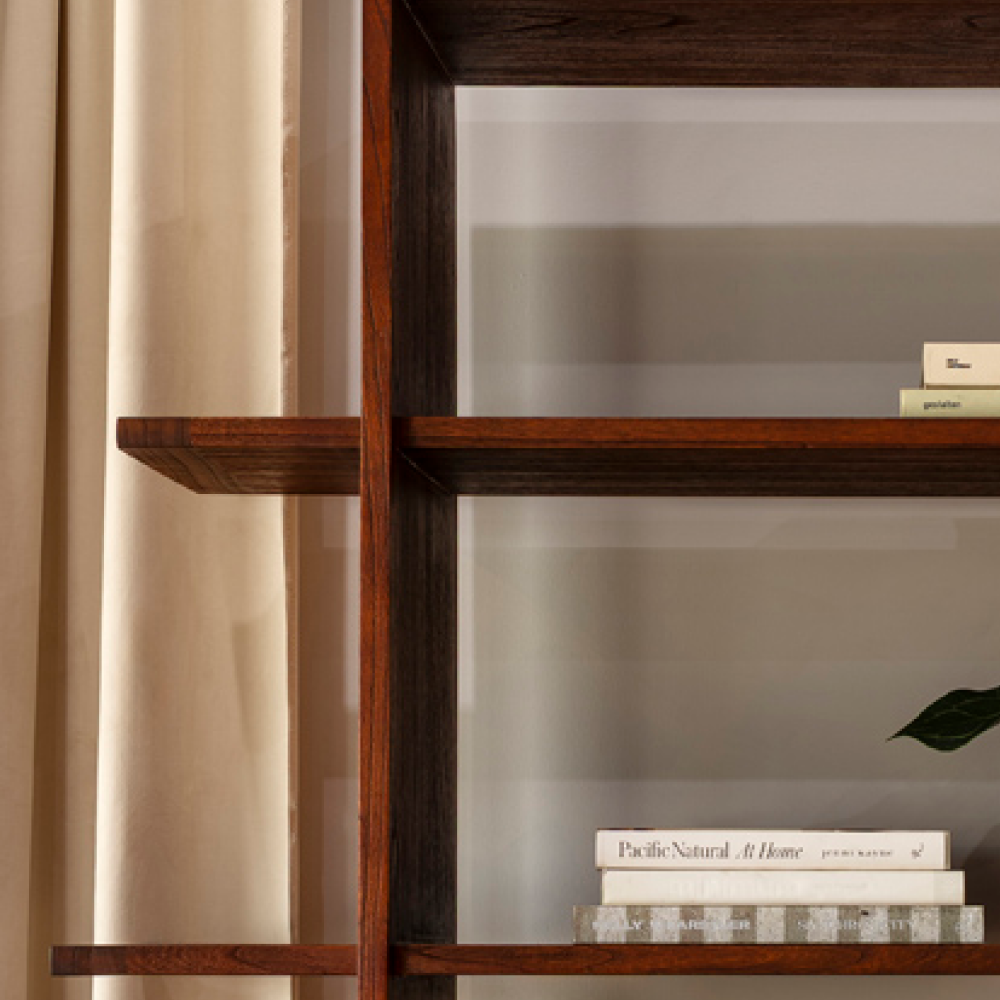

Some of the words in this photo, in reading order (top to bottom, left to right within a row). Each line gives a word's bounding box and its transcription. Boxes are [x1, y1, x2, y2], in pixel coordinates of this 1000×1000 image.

[618, 841, 670, 859] Pacific
[671, 841, 729, 859] Natural
[758, 841, 804, 860] Home
